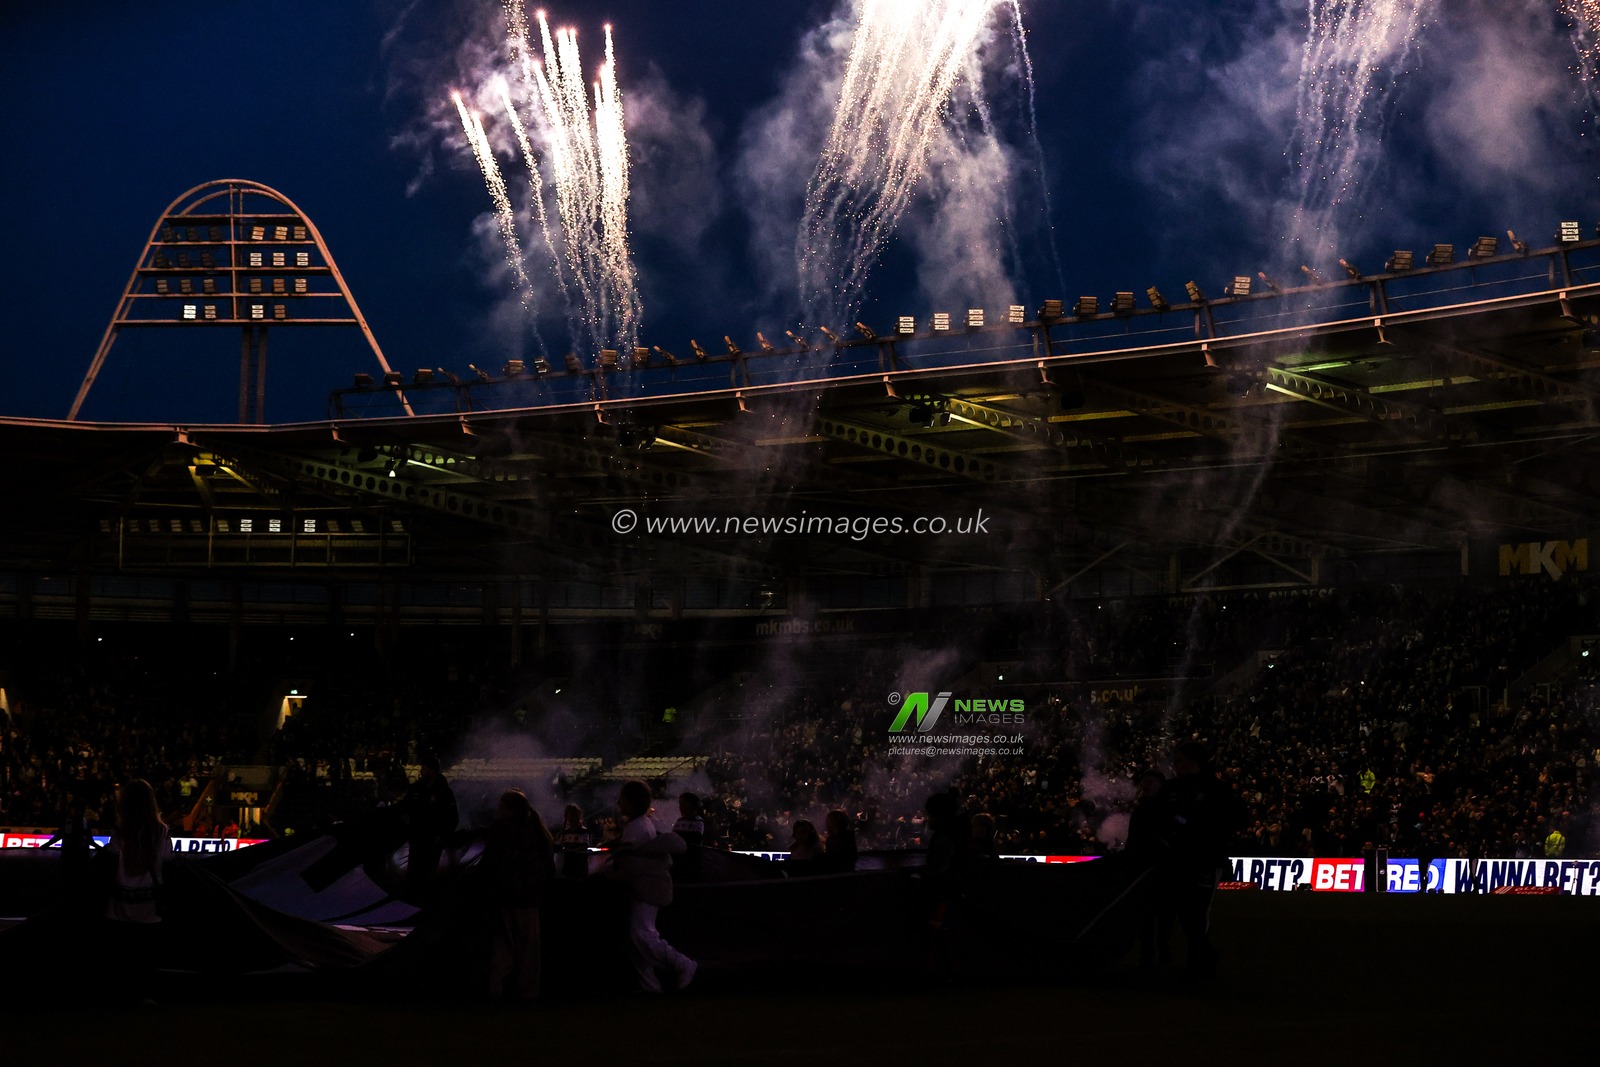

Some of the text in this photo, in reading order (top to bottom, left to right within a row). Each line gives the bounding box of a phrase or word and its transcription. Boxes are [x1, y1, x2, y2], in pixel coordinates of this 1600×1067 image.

[1499, 538, 1589, 581] MKM
[755, 617, 855, 636] mkmbs.co.uk
[1249, 859, 1304, 892] BET?
[1315, 863, 1440, 891] BET RED
[1455, 860, 1600, 897] WANNA BET?
